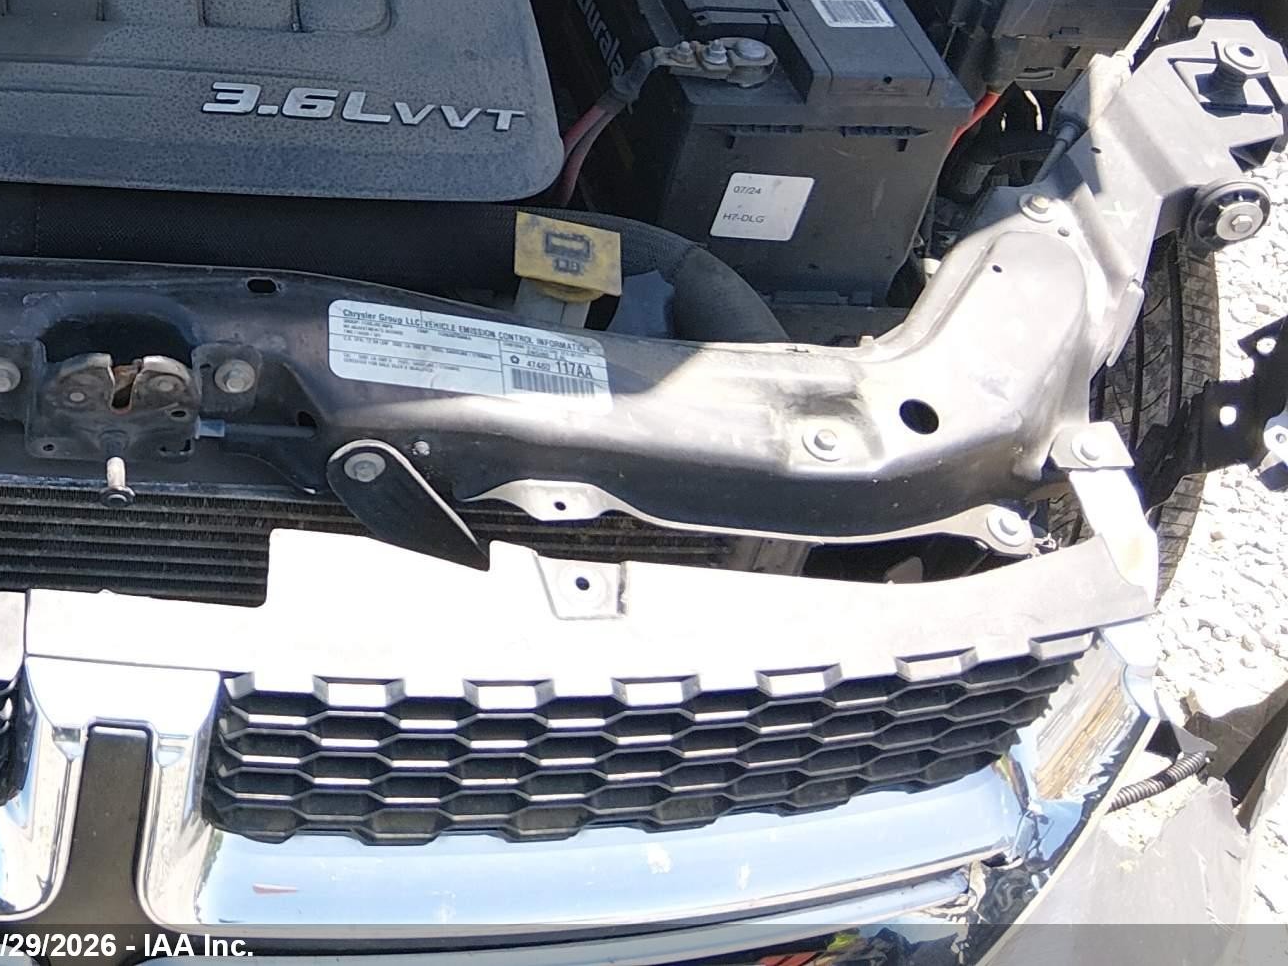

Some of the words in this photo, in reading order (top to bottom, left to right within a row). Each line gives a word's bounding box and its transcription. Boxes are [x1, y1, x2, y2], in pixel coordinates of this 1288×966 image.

[733, 185, 762, 196] 07/24
[722, 212, 765, 224] H7-DLG
[342, 308, 377, 321] Chrysler
[378, 313, 403, 325] Group
[405, 316, 421, 326] LLC
[424, 320, 455, 331] VEHICLE
[458, 325, 496, 338] EMISSION
[498, 331, 534, 344] CONTROL
[536, 337, 591, 353] INFORMATION
[556, 361, 593, 378] 117AA
